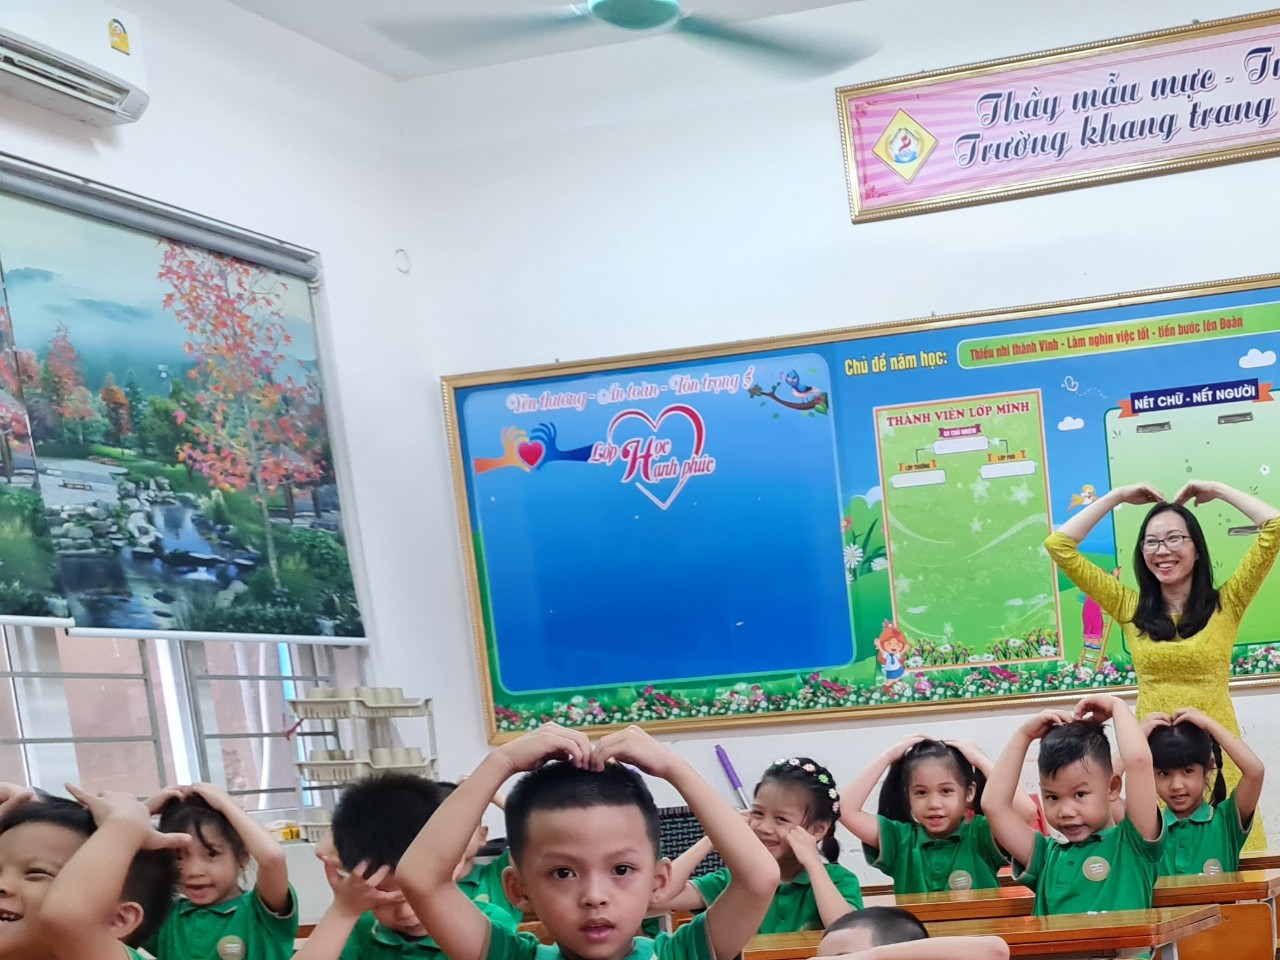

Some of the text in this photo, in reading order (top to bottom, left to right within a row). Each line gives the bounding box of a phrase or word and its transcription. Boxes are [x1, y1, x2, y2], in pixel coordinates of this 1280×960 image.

[976, 86, 1062, 128] Thầy
[1071, 72, 1142, 113] mẫu
[1150, 68, 1216, 102] mực
[955, 130, 1070, 168] Trường
[1079, 112, 1179, 148] khang
[1188, 95, 1275, 130] trang
[970, 344, 995, 361] Thiếu
[996, 344, 1010, 358] nhi
[1039, 338, 1059, 353] Vinh
[1067, 335, 1087, 350] Làm
[1088, 332, 1114, 350] nghìn
[1116, 329, 1136, 346] việc
[1158, 321, 1176, 338] tiến
[1203, 316, 1218, 333] lên
[1219, 315, 1244, 331] Đoàn
[844, 350, 948, 376] Chủ đề năm học:
[886, 399, 1030, 427] THÀNH VIÊN LỚP MÌNH
[1134, 395, 1154, 409] NÉT
[1157, 391, 1184, 407] CHỮ
[1192, 386, 1213, 403] NẾT
[1216, 384, 1256, 401] NGƯỜI
